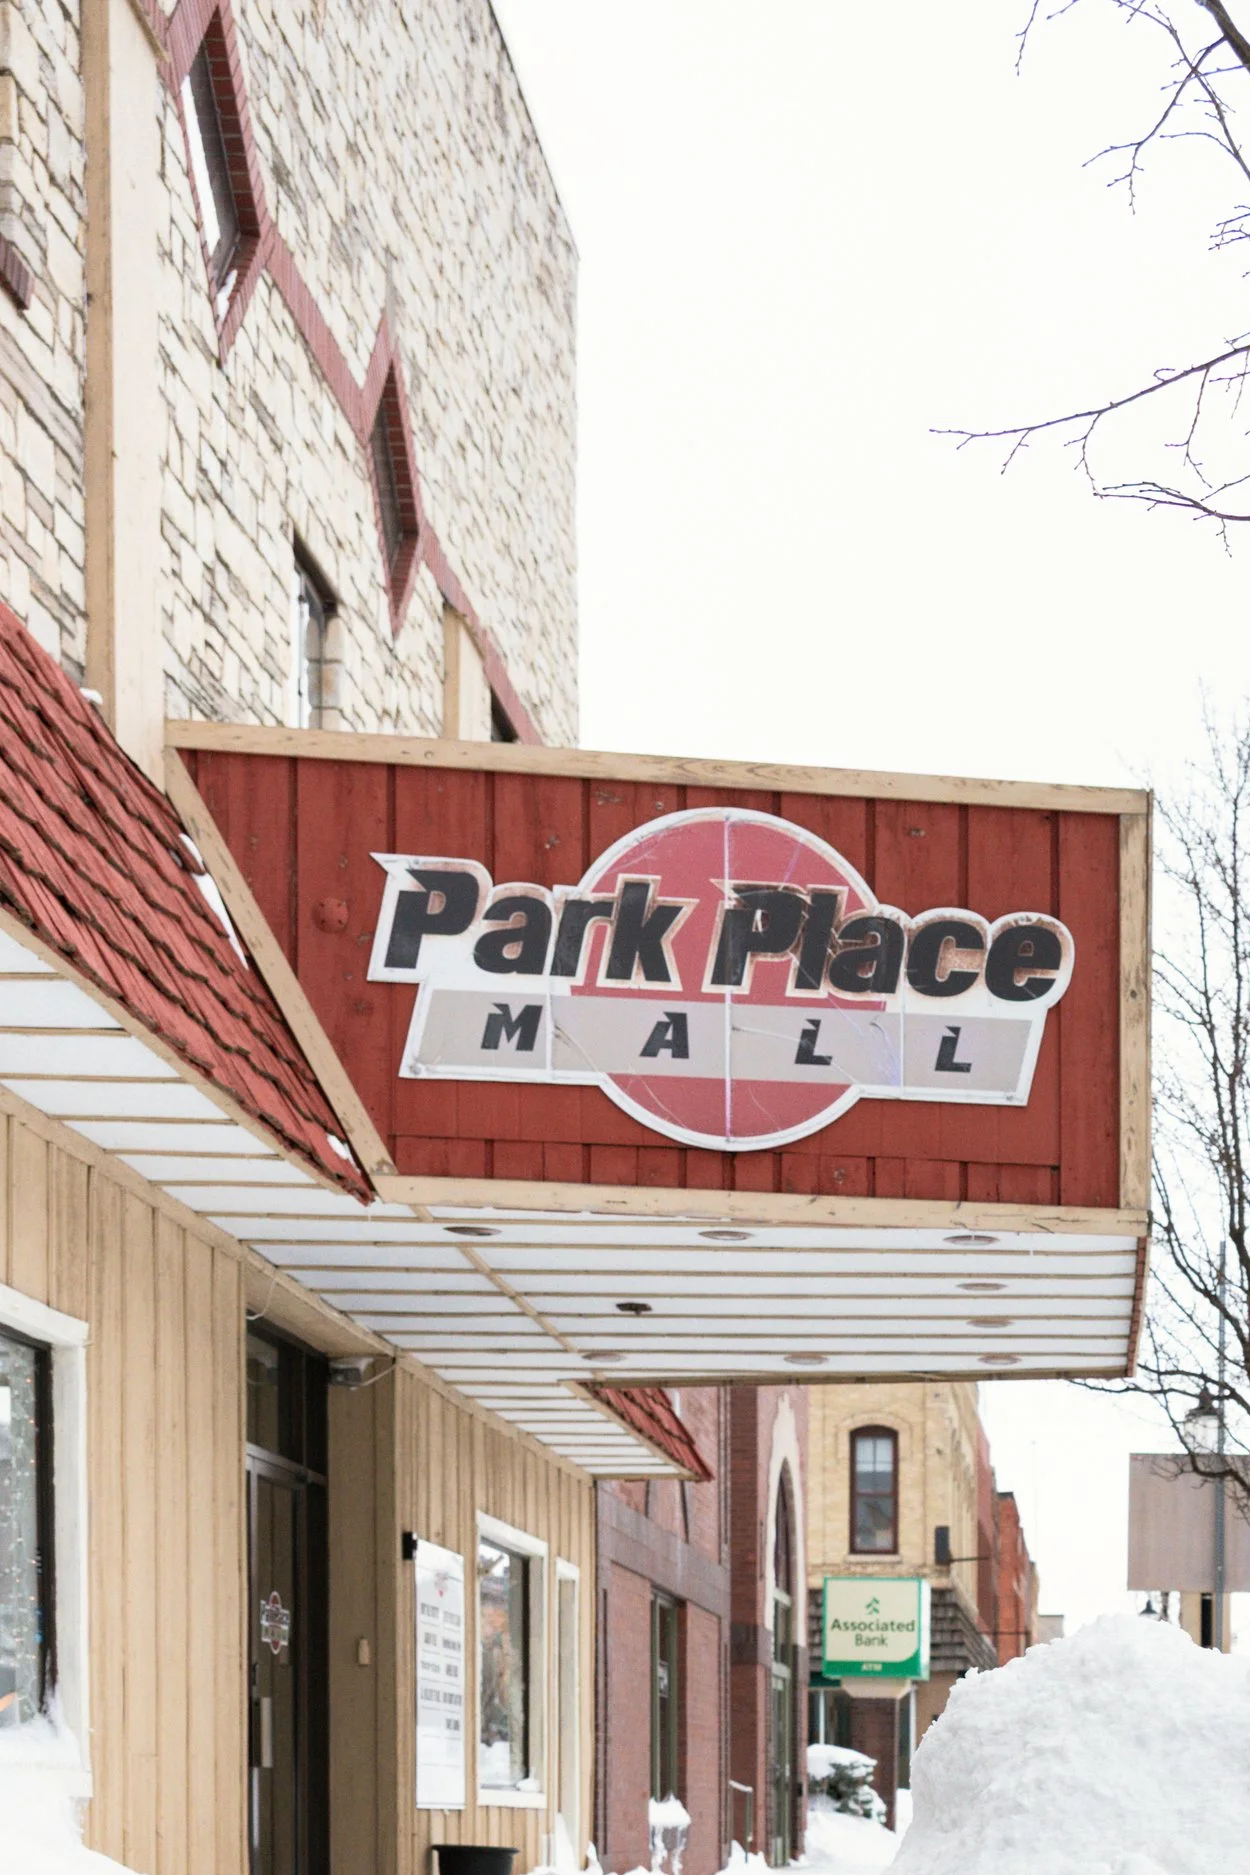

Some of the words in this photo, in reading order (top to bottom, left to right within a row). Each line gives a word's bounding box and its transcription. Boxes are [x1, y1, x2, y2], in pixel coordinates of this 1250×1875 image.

[384, 868, 690, 985] Park
[709, 882, 1061, 1002] Place
[480, 1002, 973, 1074] MALL
[830, 1618, 915, 1632] Associated
[854, 1633, 888, 1647] Bank
